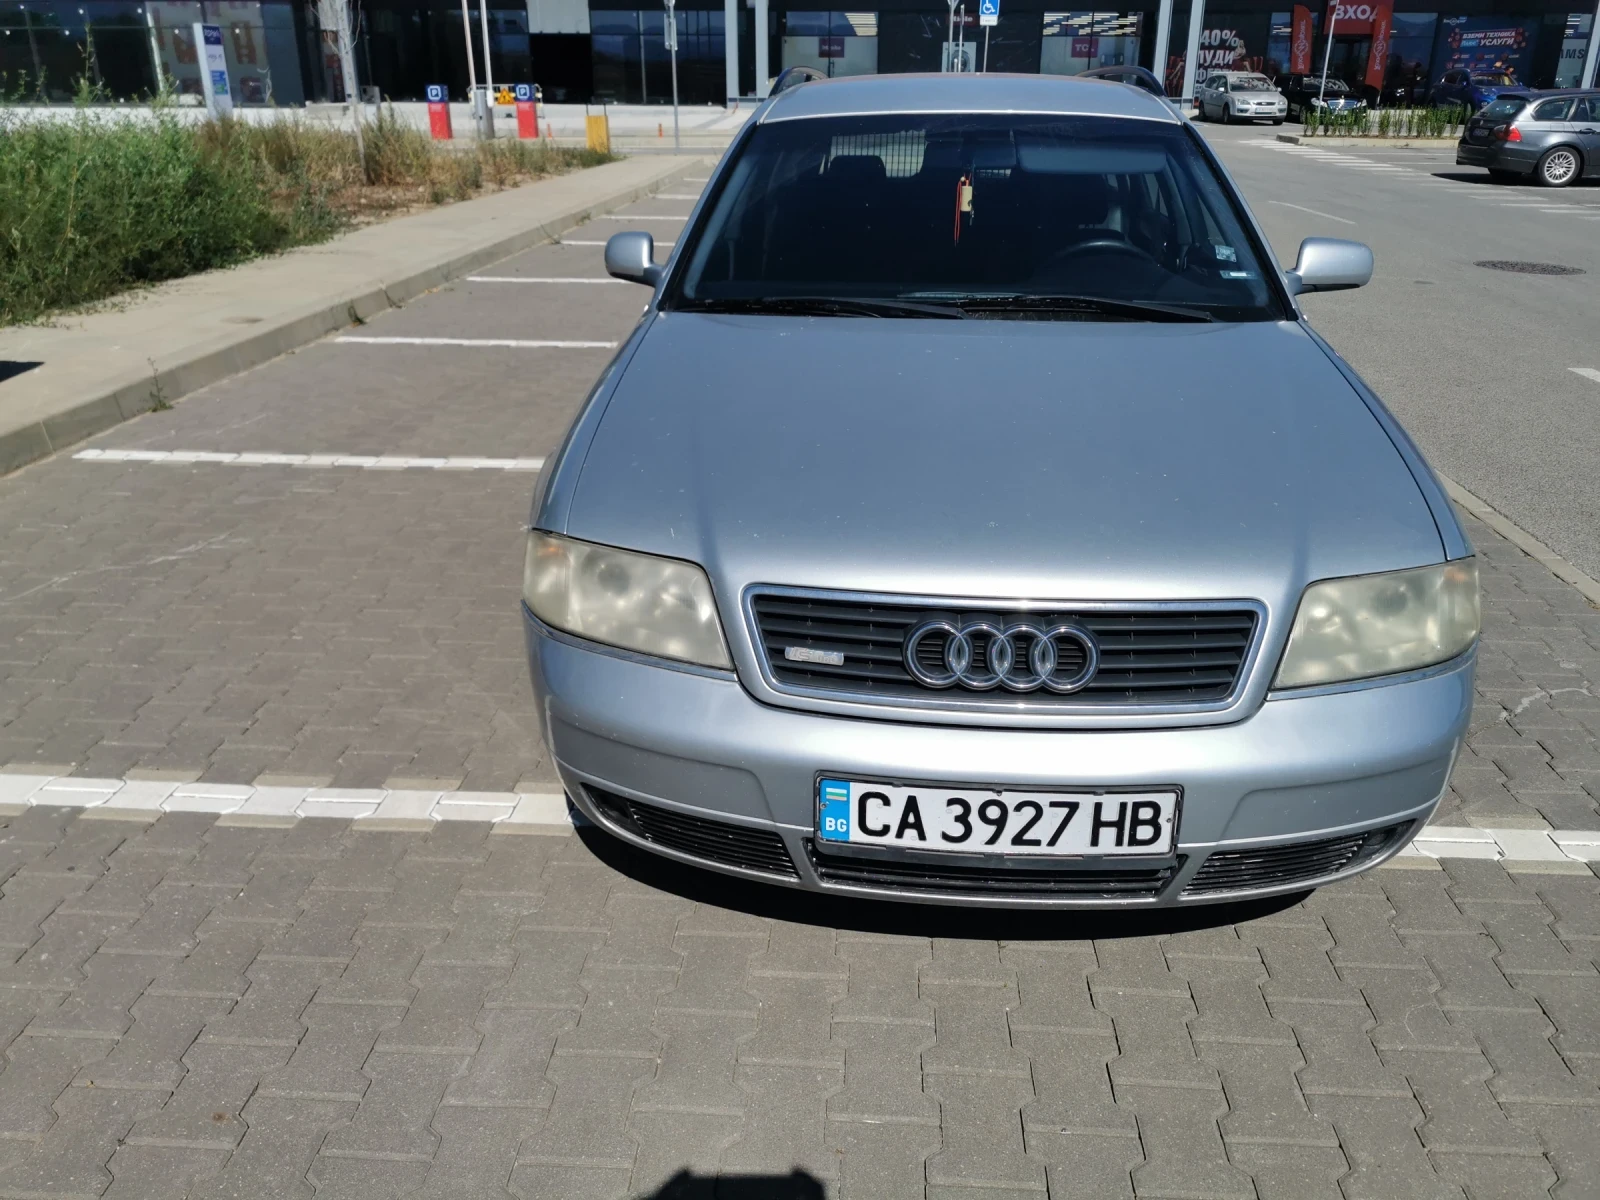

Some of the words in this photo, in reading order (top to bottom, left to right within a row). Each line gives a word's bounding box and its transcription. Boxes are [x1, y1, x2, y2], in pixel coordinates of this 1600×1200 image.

[1479, 37, 1515, 46] УСЛУГИ
[1074, 44, 1095, 52] TC
[824, 817, 848, 833] BG
[857, 791, 927, 841] CA
[940, 796, 1081, 847] 3927
[1089, 800, 1163, 848] HB
